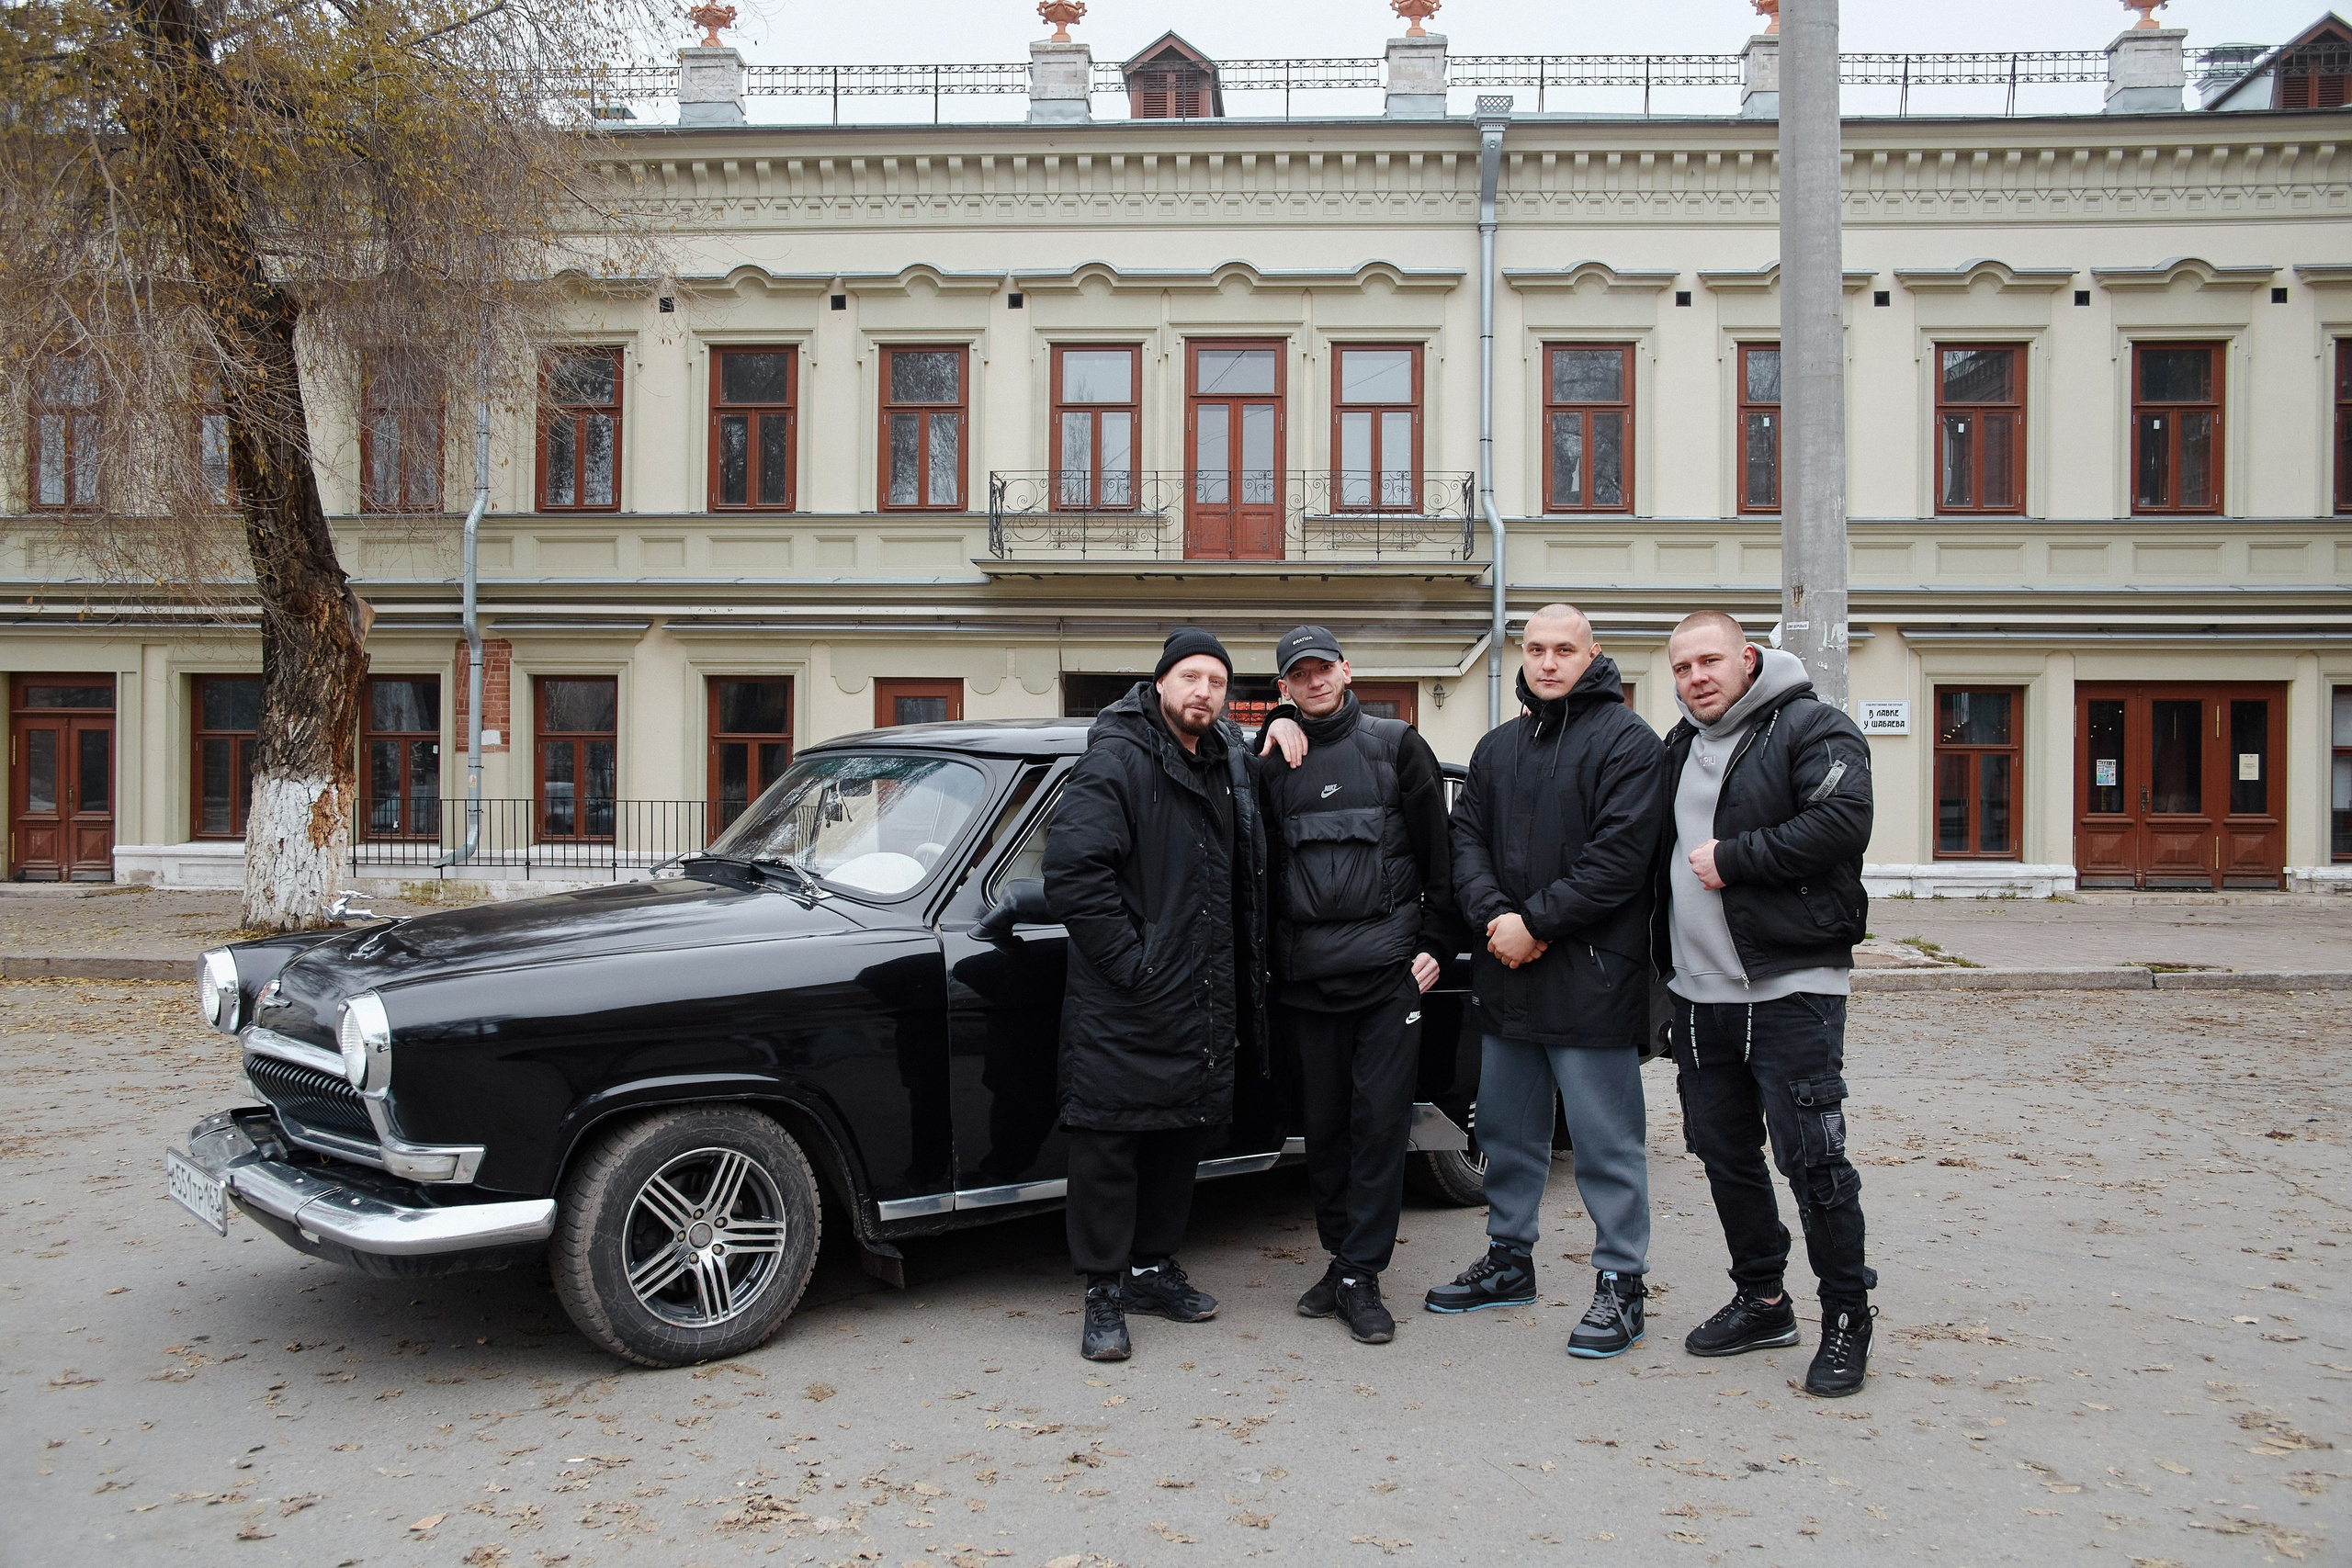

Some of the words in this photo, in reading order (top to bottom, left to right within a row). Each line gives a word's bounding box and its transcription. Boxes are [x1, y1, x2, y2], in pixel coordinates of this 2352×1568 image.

[1869, 709, 1874, 719] В
[1876, 709, 1899, 717] ЛАВКЕ
[1863, 720, 1869, 730] У
[1324, 784, 1338, 792] NIKE
